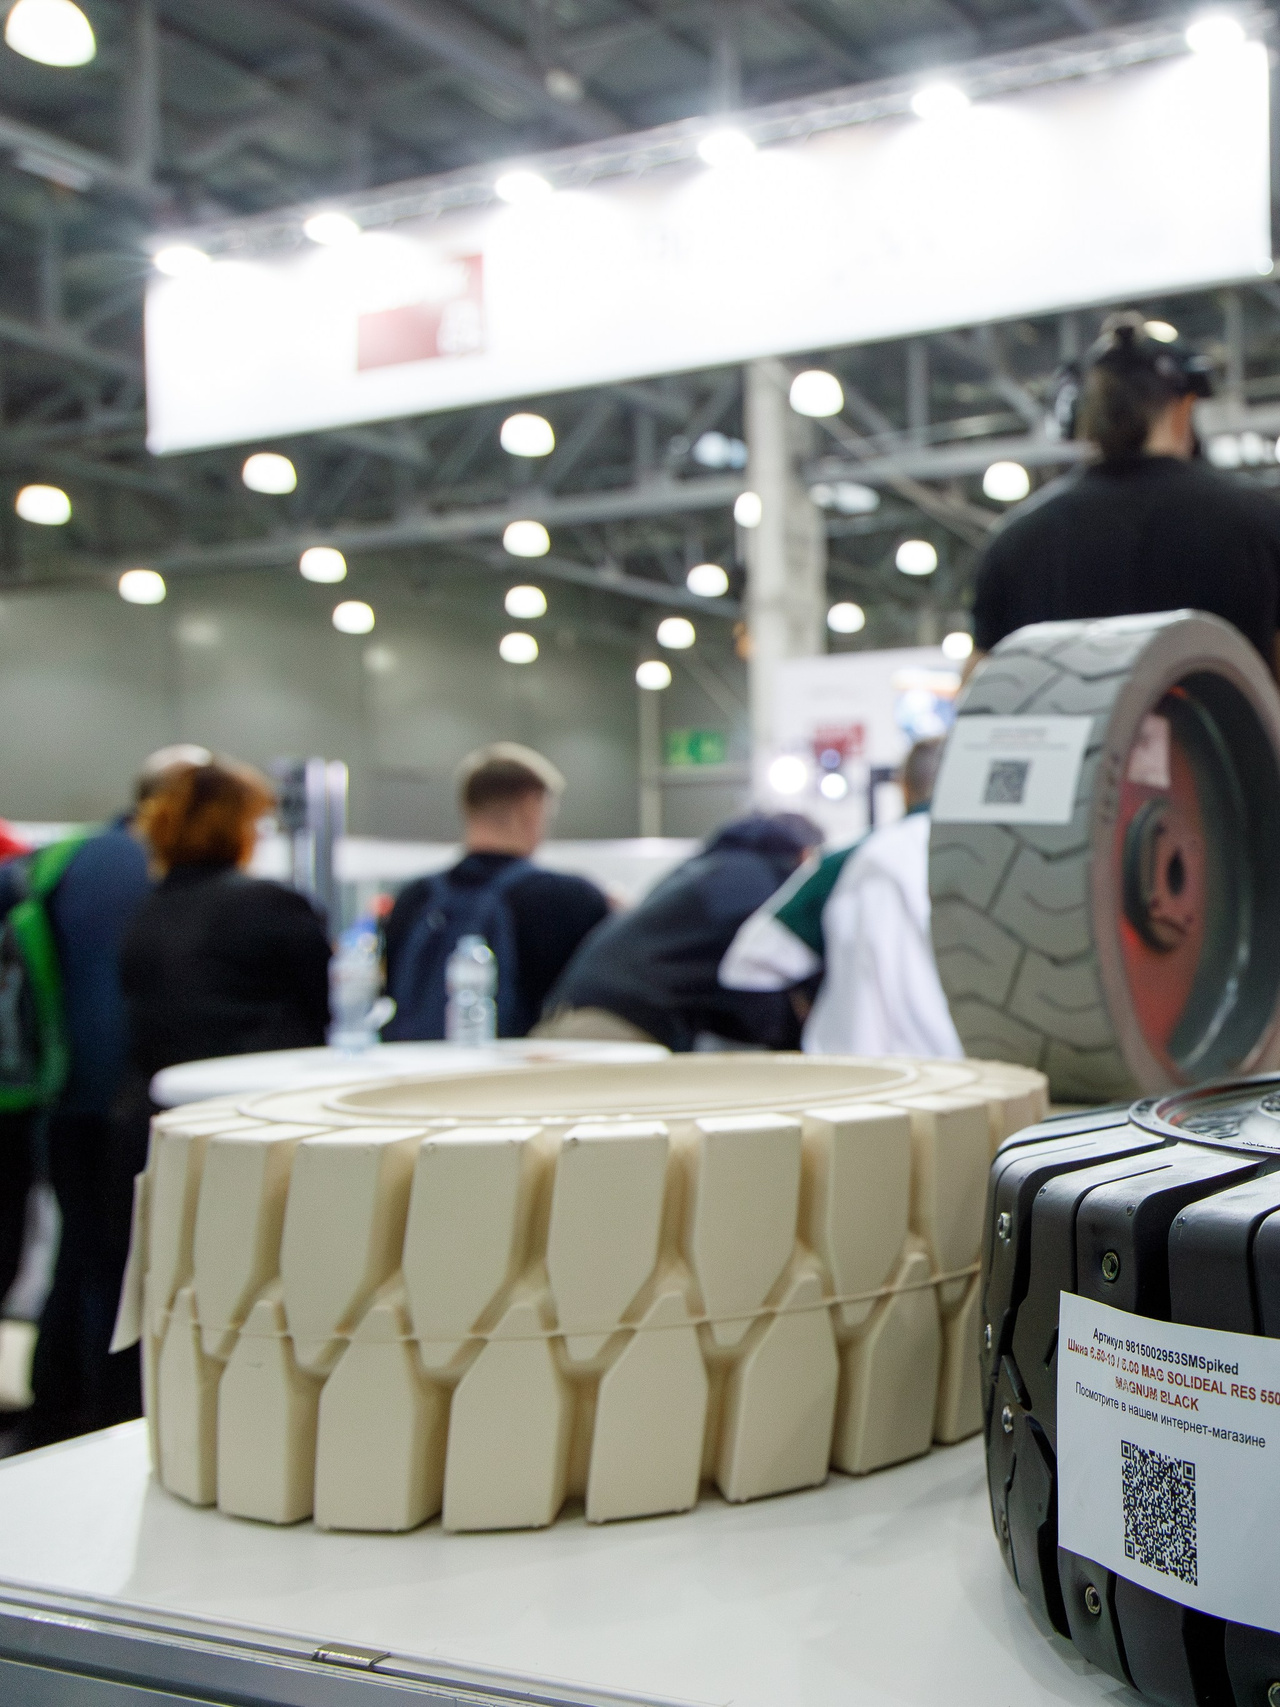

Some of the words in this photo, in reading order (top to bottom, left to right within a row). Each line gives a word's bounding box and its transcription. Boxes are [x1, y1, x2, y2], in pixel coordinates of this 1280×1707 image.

[1092, 1327, 1124, 1351] Артикул
[1125, 1339, 1239, 1376] 9815002953SMSpiked
[1114, 1376, 1158, 1401] MAGNUM
[1160, 1390, 1199, 1412] BLACK
[1141, 1363, 1165, 1382] MAG
[1167, 1371, 1227, 1396] SOLIDEAL
[1230, 1383, 1257, 1401] RES
[1075, 1381, 1119, 1409] Посмотрите
[1121, 1401, 1127, 1412] в
[1128, 1404, 1159, 1423] нашем
[1160, 1414, 1266, 1448] интернет-магазине
